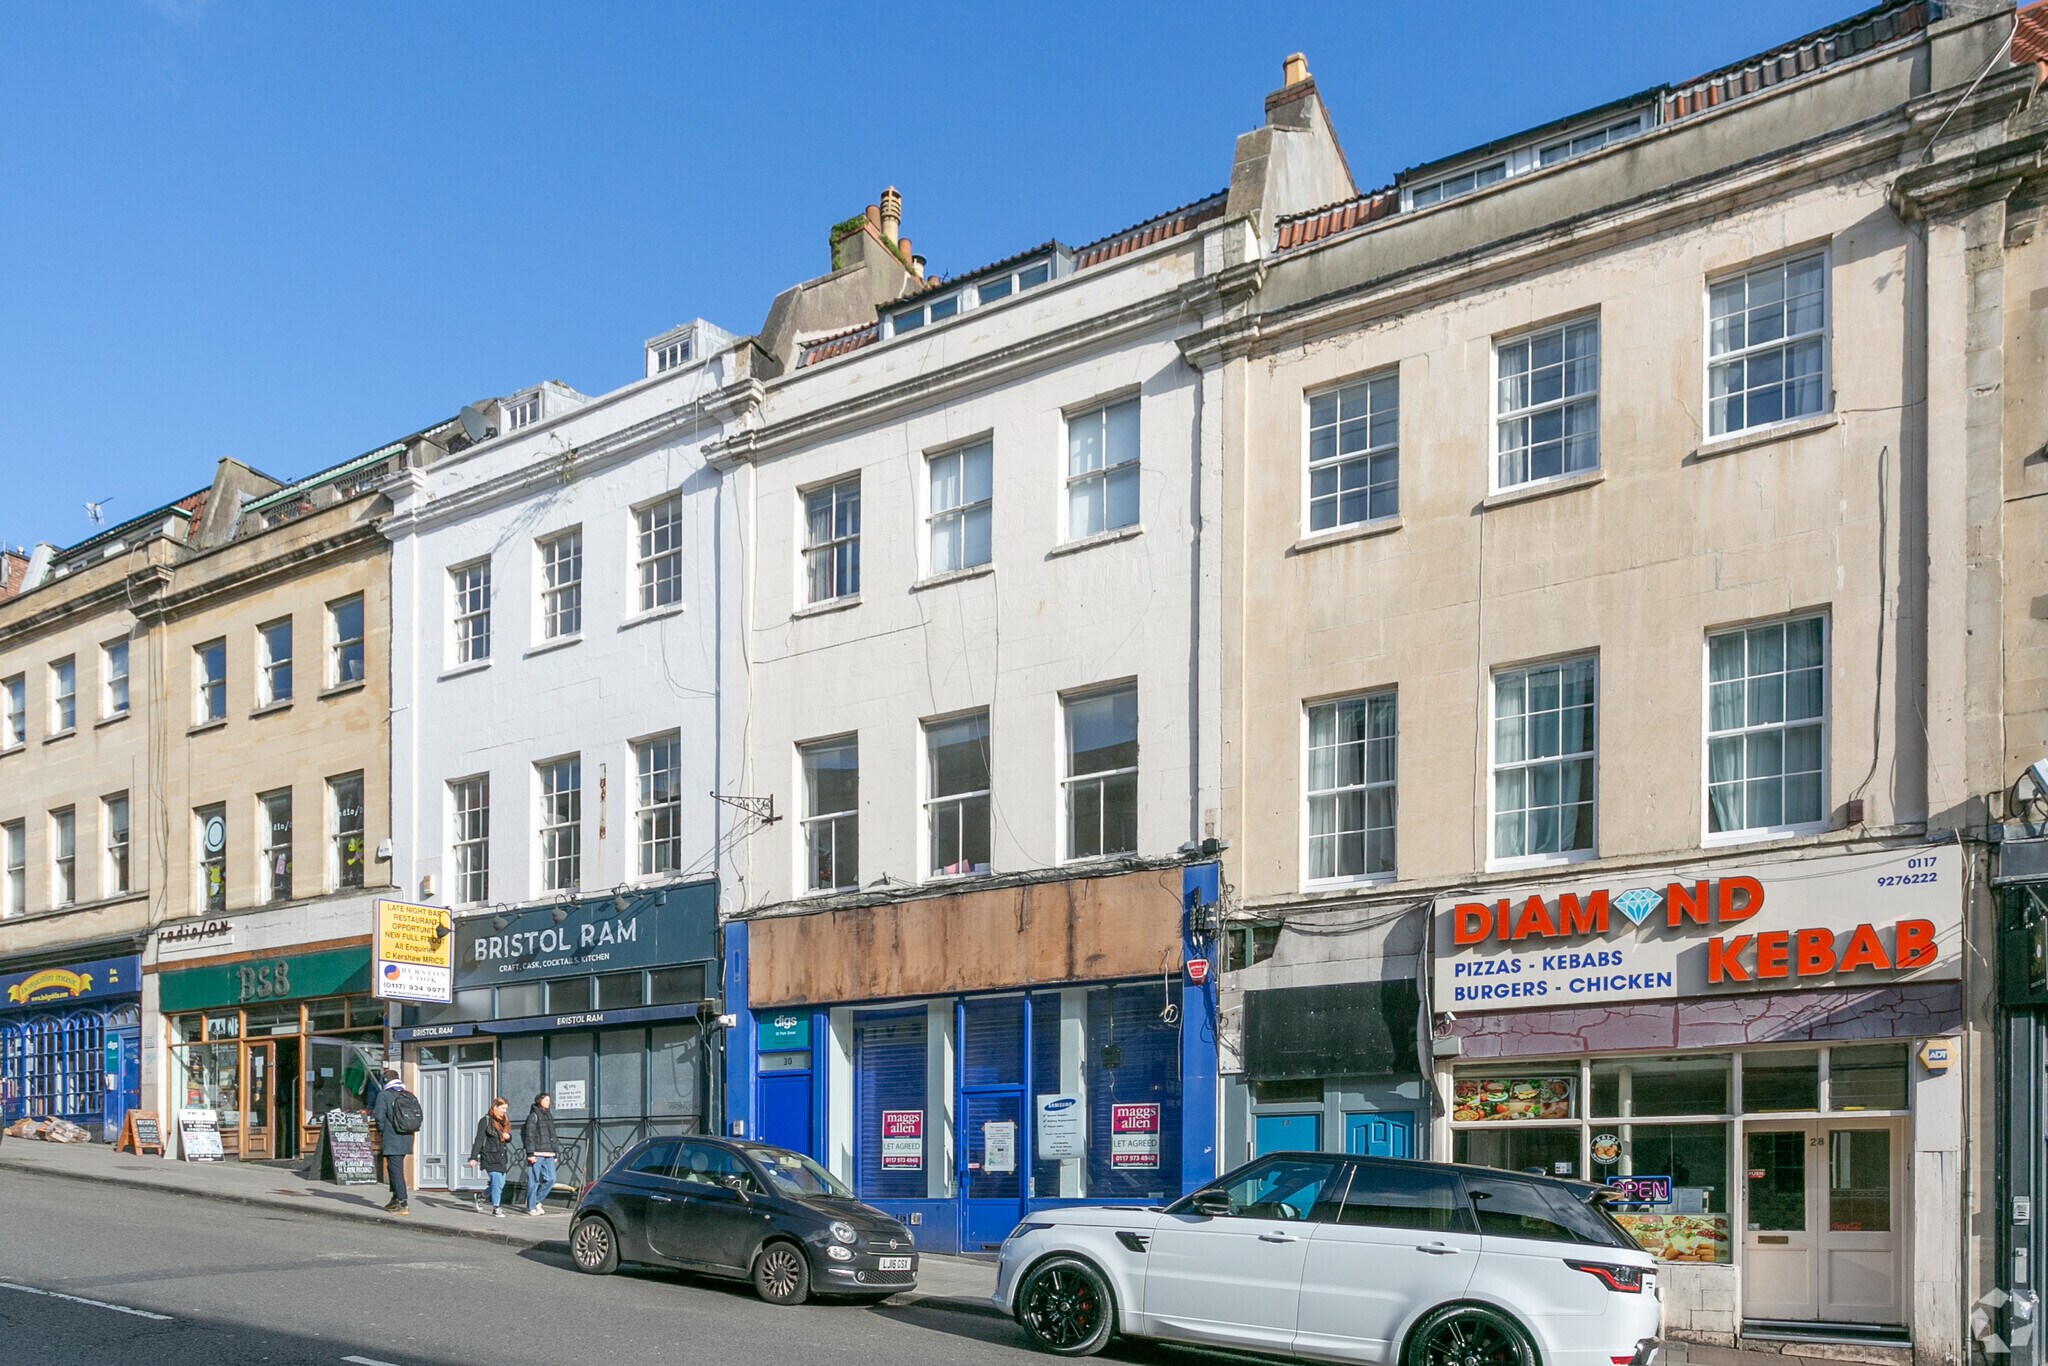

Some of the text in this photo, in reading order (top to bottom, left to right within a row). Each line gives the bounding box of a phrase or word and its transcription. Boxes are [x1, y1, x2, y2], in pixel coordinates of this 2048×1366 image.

[1908, 856, 1938, 869] 0117
[1877, 872, 1938, 887] 9276222
[387, 903, 441, 918] LATE NIGHT BAR
[393, 913, 438, 925] RESTAURANT
[158, 919, 232, 942] radio/ON
[392, 922, 436, 935] OPPORTUNIT
[384, 931, 401, 940] NEW
[402, 933, 419, 942] FULL
[420, 935, 430, 943] FIT
[474, 917, 637, 961] BRISTOL RAM
[395, 942, 436, 954] All Enquiries
[1707, 918, 1939, 984] KEBAB
[385, 951, 445, 965] C Kershaw MRICS
[499, 961, 521, 973] CRAFT,
[522, 960, 542, 970] CASK,
[581, 952, 610, 964] KITCHEN
[1454, 958, 1522, 978] PIZZAS
[1542, 950, 1623, 972] KEBABS
[236, 959, 290, 1004] BS8
[383, 982, 406, 990] (0117)
[427, 985, 446, 993] 9977
[1454, 980, 1548, 1001] BURGERS
[1568, 971, 1673, 994] CHICKEN
[556, 1013, 604, 1026] BRISTOL RAM
[774, 1014, 798, 1029] digs
[412, 1026, 454, 1037] BRISTOL RAM
[1929, 1050, 1948, 1059] ADT
[783, 1057, 793, 1066] 30
[327, 1112, 346, 1125] BS8
[887, 1113, 920, 1125] maggs
[1117, 1107, 1157, 1120] maggs
[890, 1122, 915, 1133] allen
[1121, 1116, 1151, 1129] allen
[883, 1142, 920, 1150] LET AGREED
[1113, 1139, 1158, 1148] LET AGREED
[1809, 1137, 1825, 1147] 28
